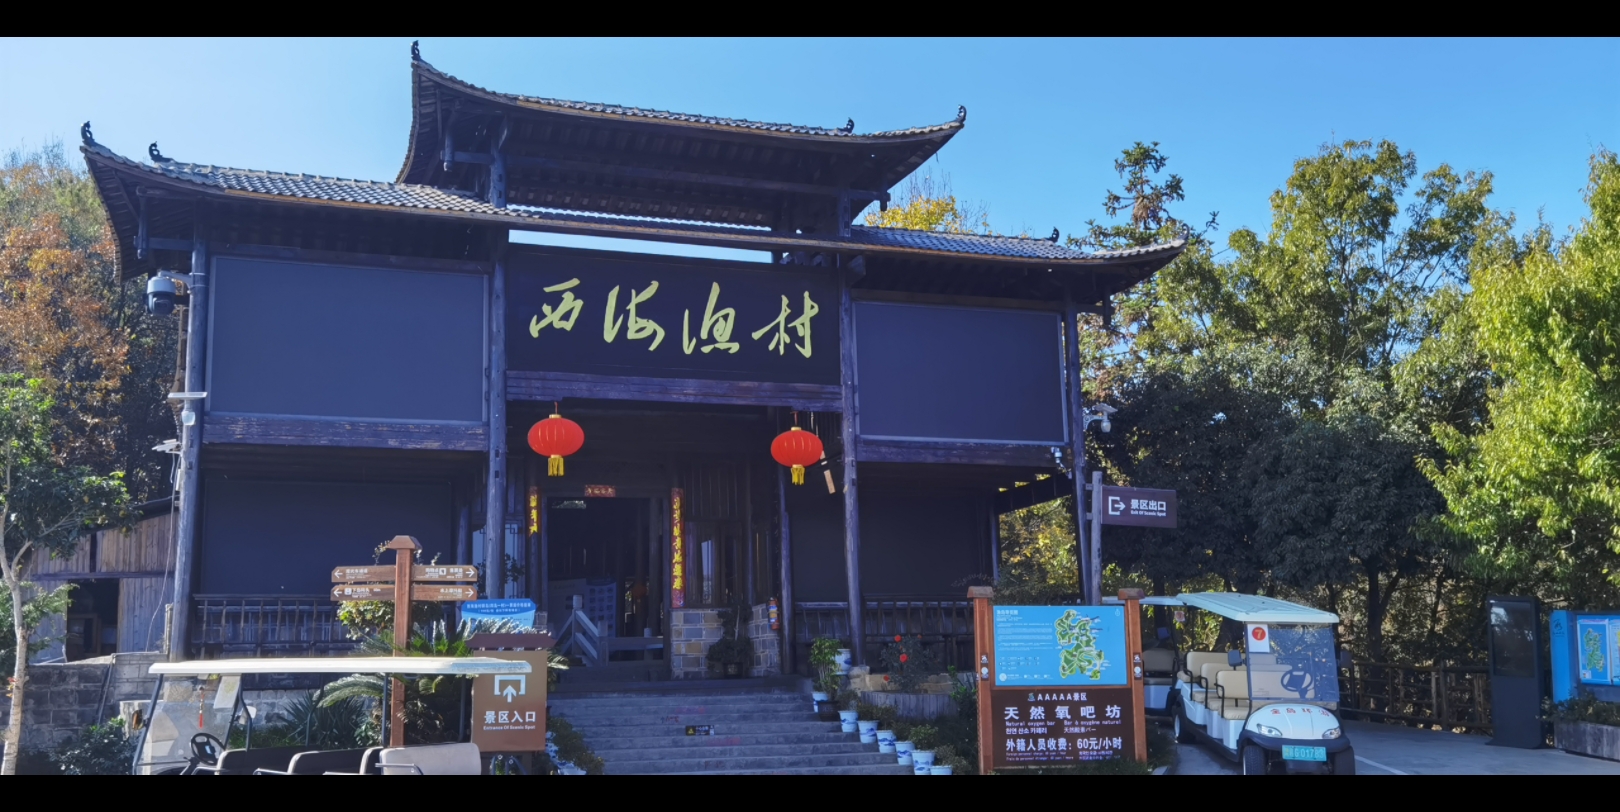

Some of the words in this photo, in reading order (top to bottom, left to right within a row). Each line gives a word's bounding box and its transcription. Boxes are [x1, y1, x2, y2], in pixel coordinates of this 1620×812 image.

[528, 277, 819, 358] 西海渔村
[1130, 498, 1167, 511] 景区出口
[1254, 629, 1262, 639] 7
[483, 710, 536, 724] 景区入口
[1004, 704, 1121, 720] 天然氧吧坊
